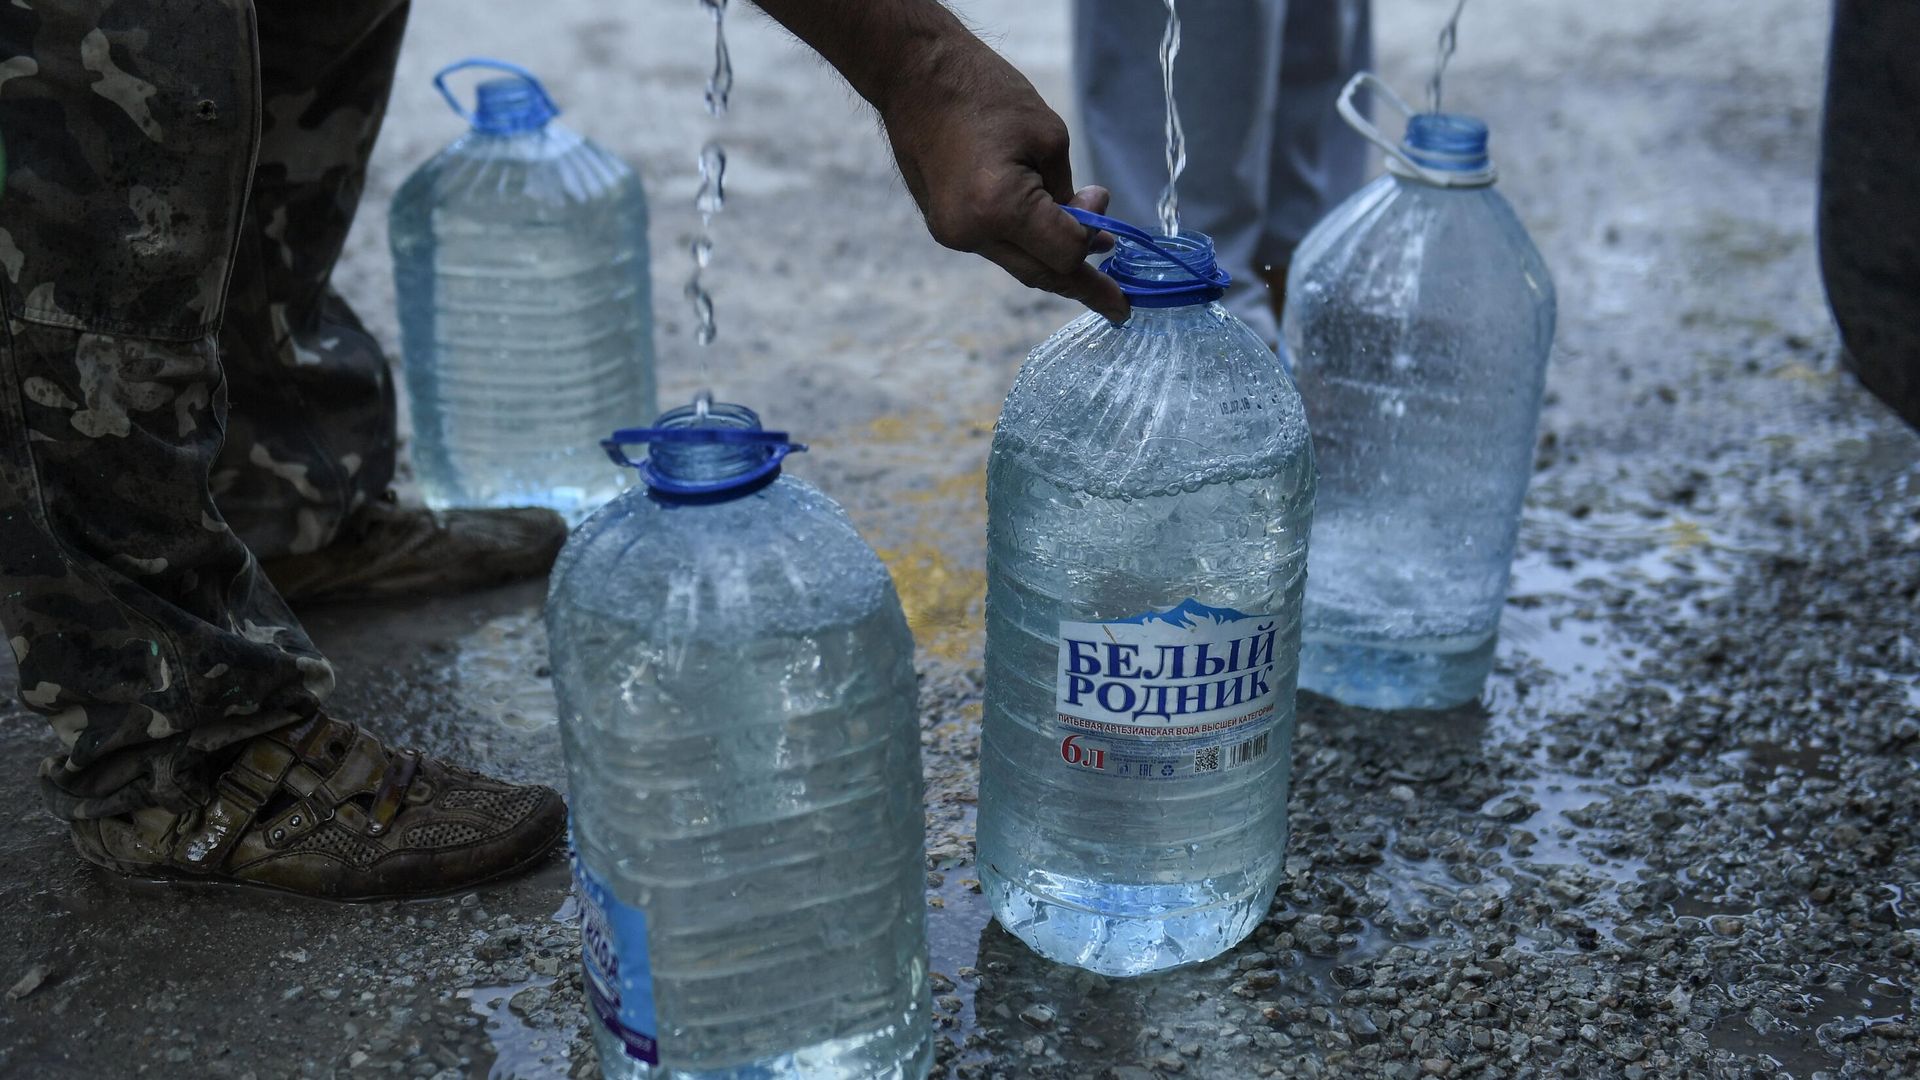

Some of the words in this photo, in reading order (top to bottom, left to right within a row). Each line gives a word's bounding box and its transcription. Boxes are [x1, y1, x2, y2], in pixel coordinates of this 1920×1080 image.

[1064, 621, 1278, 680] БЕЛЫЙ
[1064, 664, 1273, 723] РОДНИК
[1058, 713, 1102, 731] ПИТЬЕВАЯ
[1104, 724, 1174, 736] АРТЕЗИАНСКАЯ
[1176, 726, 1199, 736] ВОДА
[1202, 719, 1237, 732] ВЫСШЕЙ
[1238, 703, 1274, 724] КАТЕГОРИИ
[1061, 734, 1105, 770] 6л
